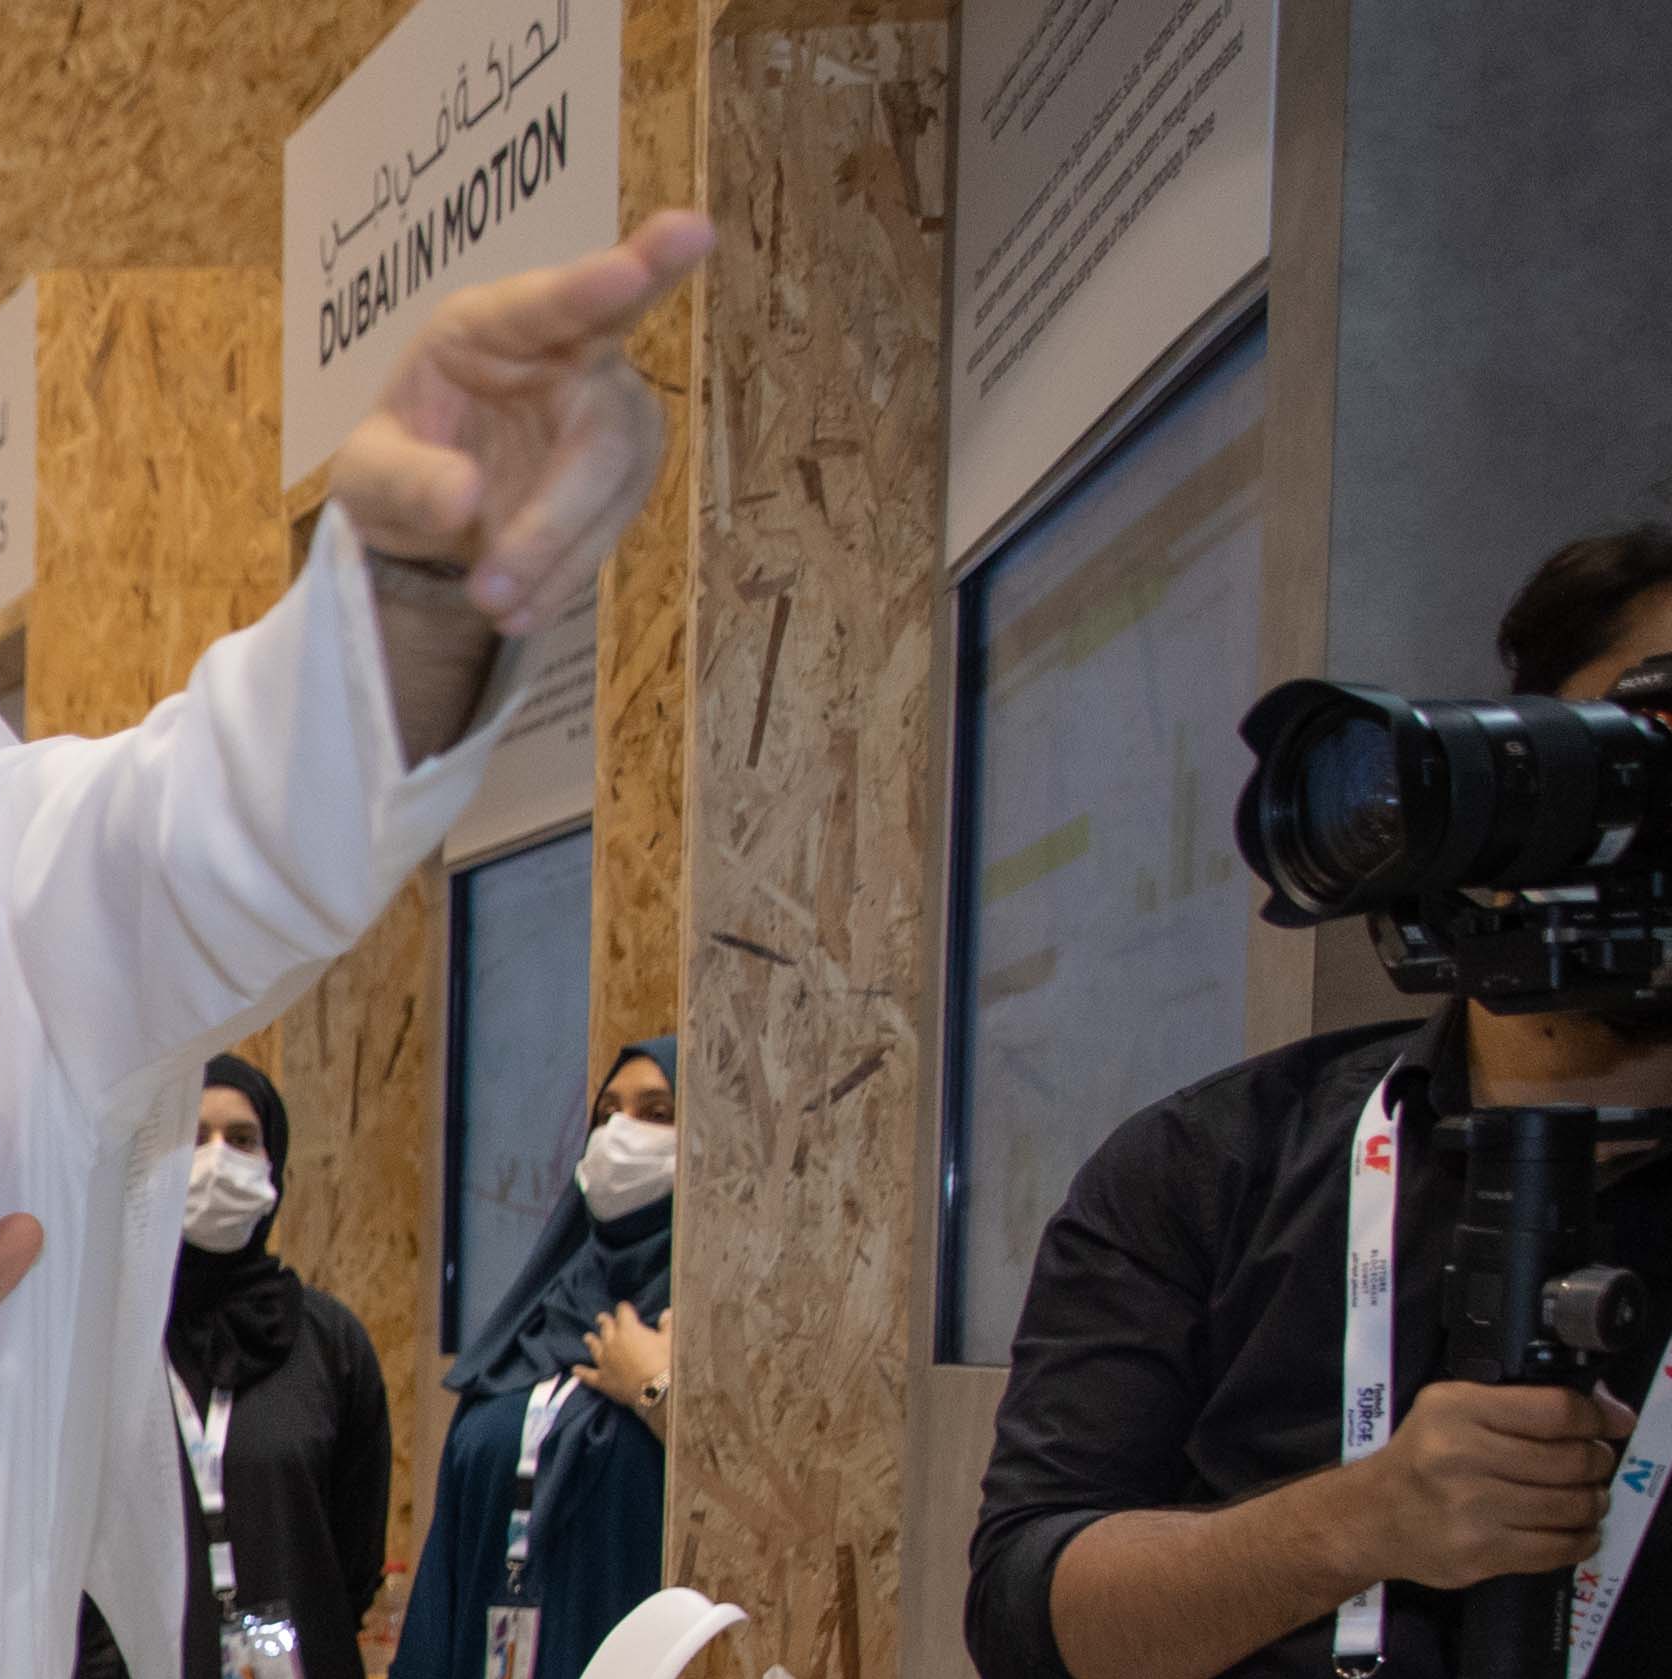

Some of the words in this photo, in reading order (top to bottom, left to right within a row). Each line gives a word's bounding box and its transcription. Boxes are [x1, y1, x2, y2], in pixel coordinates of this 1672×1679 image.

[320, 240, 399, 367] DUBAI
[407, 209, 434, 298] IN
[442, 91, 567, 269] MOTION
